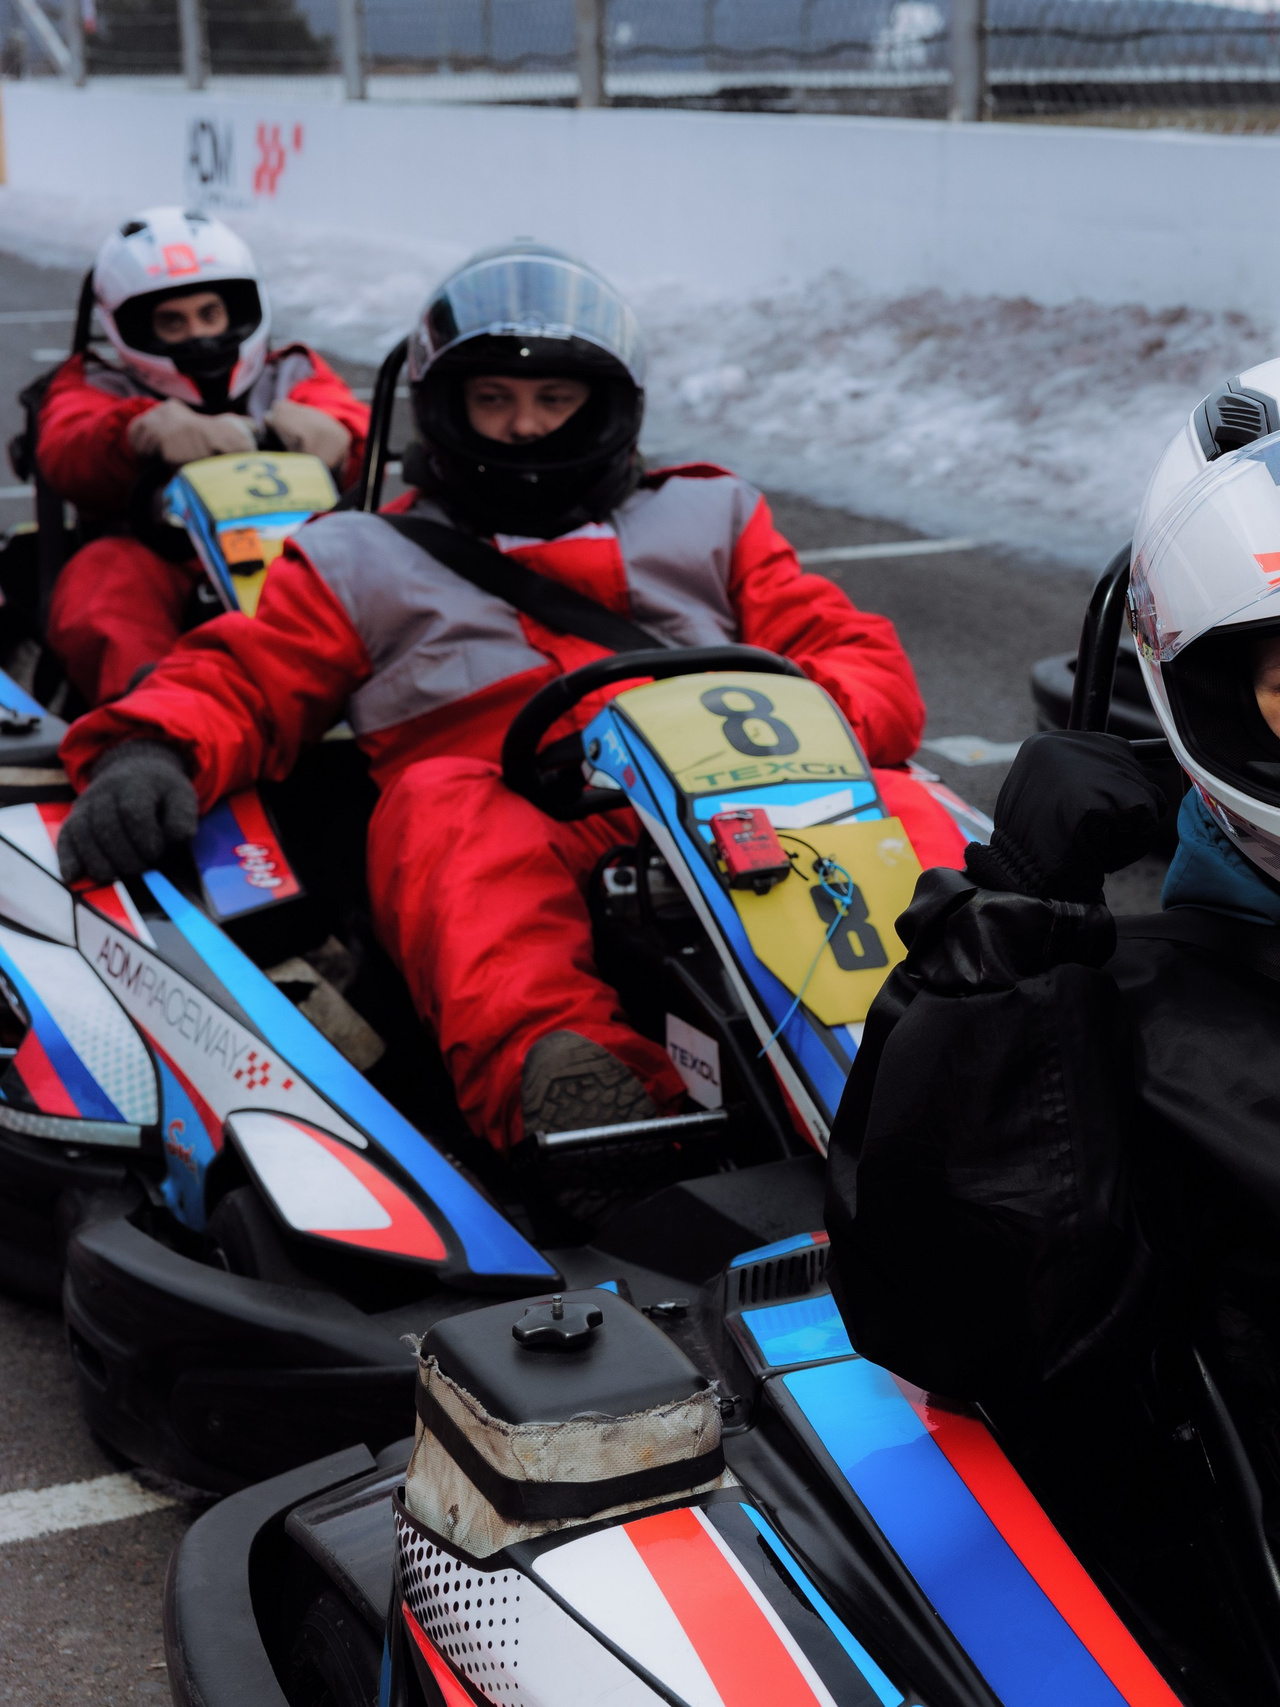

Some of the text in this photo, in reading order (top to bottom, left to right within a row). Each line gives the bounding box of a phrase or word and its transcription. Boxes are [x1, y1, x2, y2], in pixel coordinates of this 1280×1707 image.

[234, 458, 289, 498] 3
[700, 686, 799, 756] 8
[694, 761, 864, 787] TEXOL
[810, 882, 889, 971] 8
[669, 1042, 719, 1087] TEXOL
